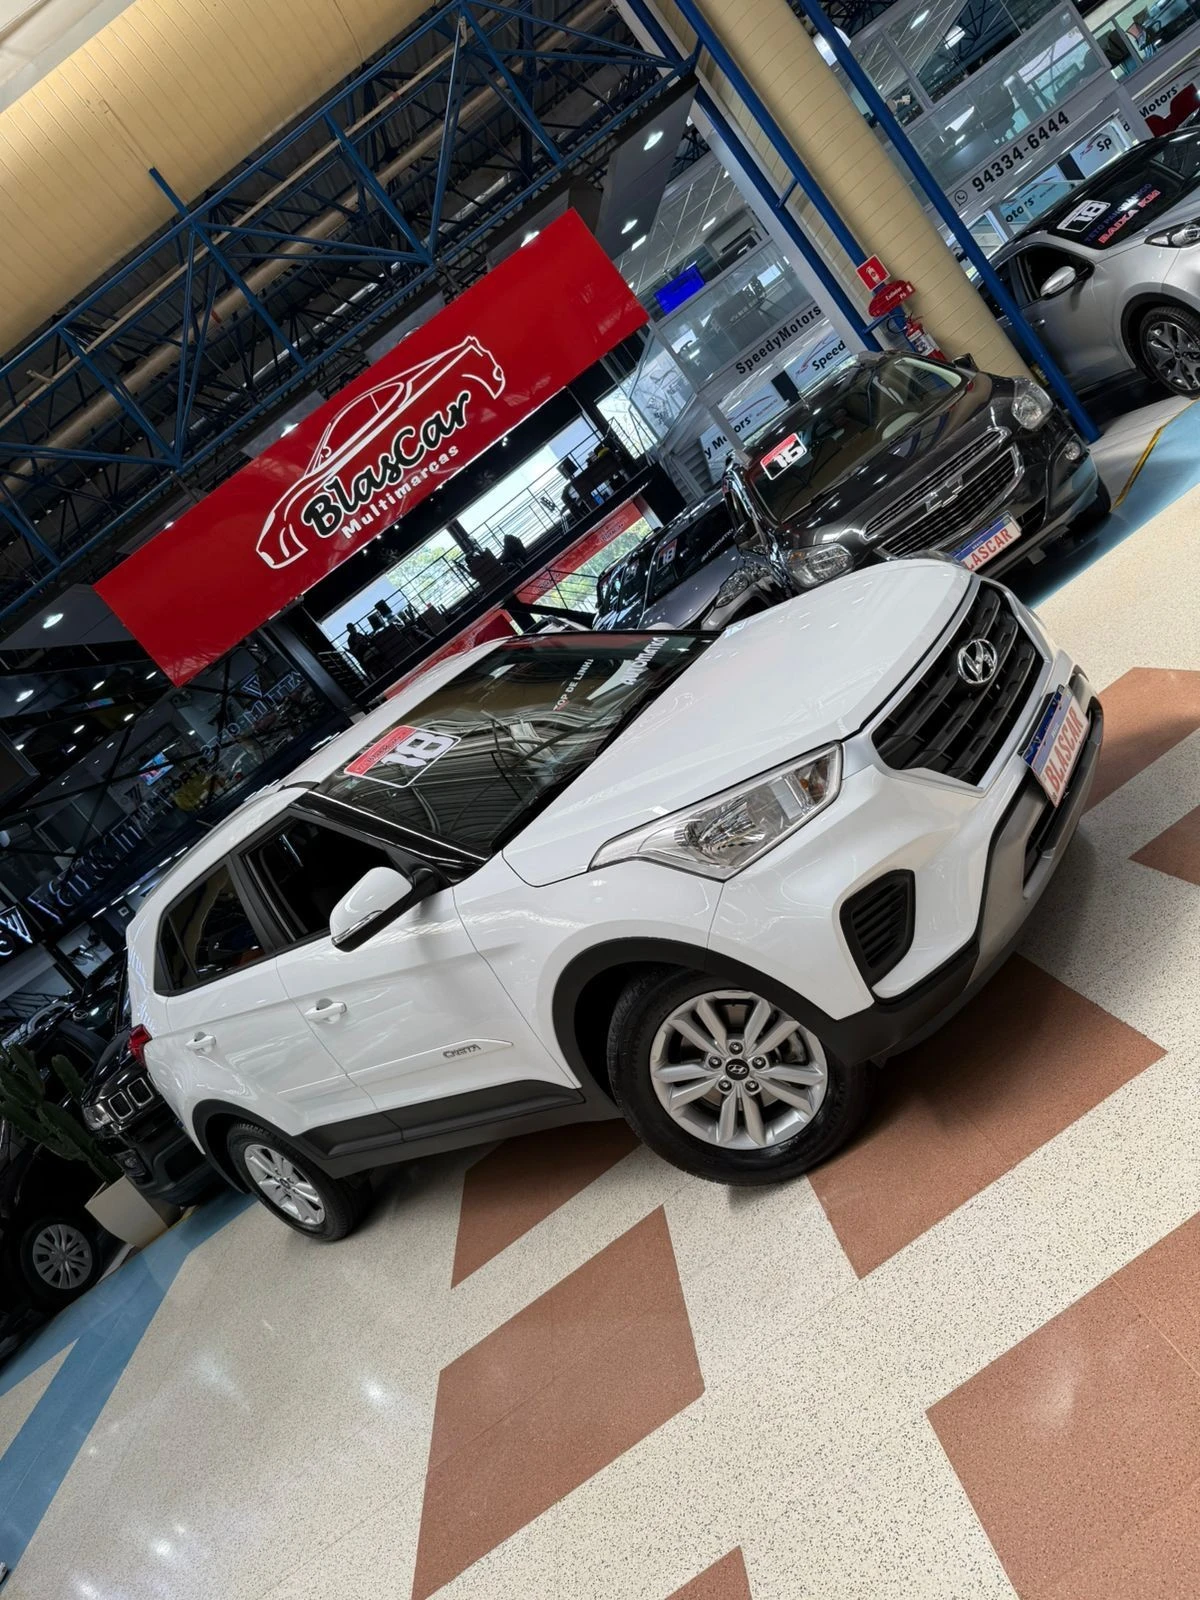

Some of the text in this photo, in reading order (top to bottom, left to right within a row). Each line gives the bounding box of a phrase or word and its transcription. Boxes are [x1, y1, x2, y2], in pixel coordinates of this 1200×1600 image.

[972, 111, 1069, 192] 94334-6444
[1073, 202, 1107, 222] 18
[1098, 209, 1139, 244] BAIXA
[736, 305, 822, 374] SpeedyMotors
[301, 390, 471, 538] BlasCar
[773, 442, 805, 468] 16
[341, 445, 459, 538] Multimarcas
[662, 548, 677, 566] 18
[962, 527, 1013, 572] LASCAR
[565, 681, 578, 693] DE
[380, 732, 455, 768] 18
[1044, 706, 1084, 793] BLASCAR
